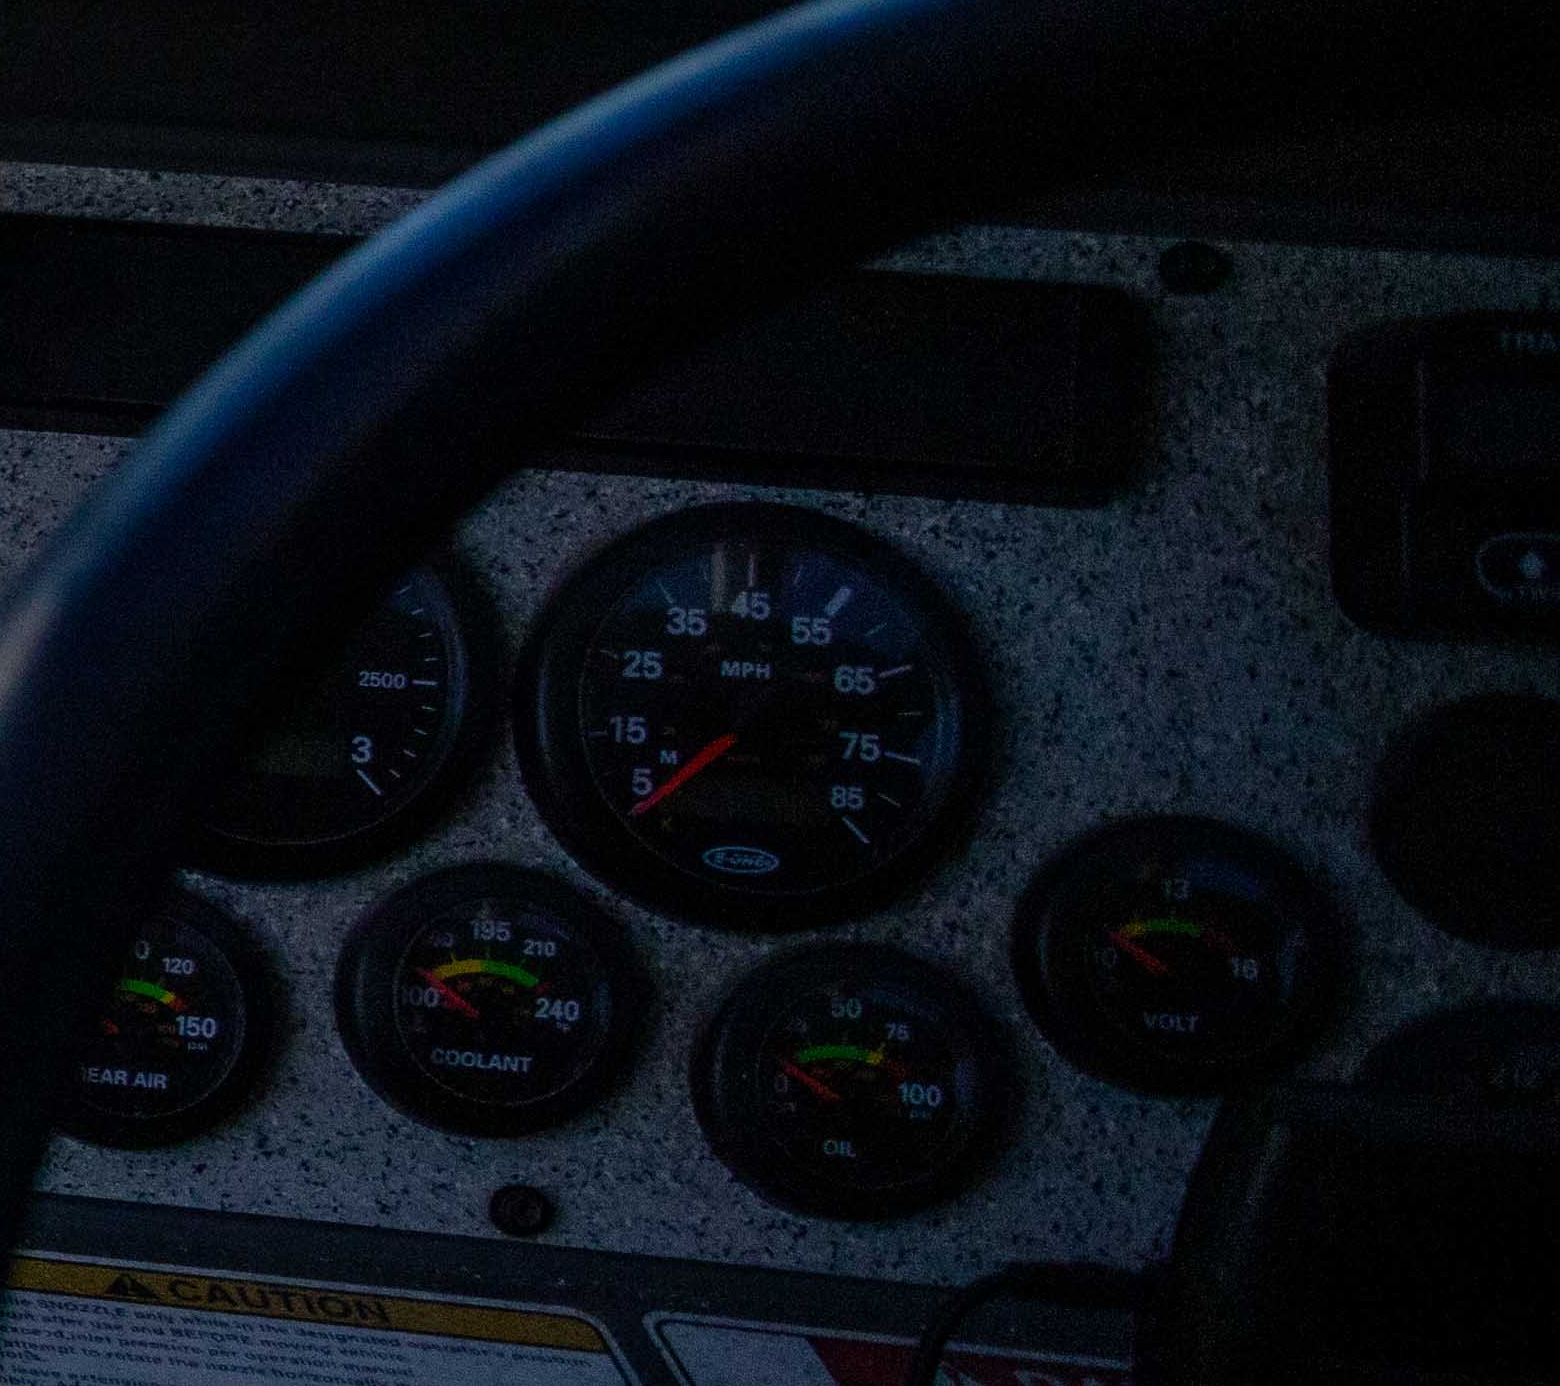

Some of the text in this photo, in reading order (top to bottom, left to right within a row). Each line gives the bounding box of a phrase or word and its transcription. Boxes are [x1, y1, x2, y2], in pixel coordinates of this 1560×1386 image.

[731, 590, 770, 621] 45
[666, 607, 707, 637] 35
[791, 616, 832, 646] 55
[622, 649, 663, 679] 25
[721, 661, 771, 678] MPH
[359, 670, 408, 689] 2500
[833, 665, 874, 695] 65
[610, 716, 647, 745] 15
[351, 736, 373, 763] 3
[839, 732, 880, 762] 75
[632, 767, 653, 796] 5
[831, 785, 864, 810] 85
[472, 919, 511, 942] 195
[523, 939, 556, 957] 210
[161, 957, 196, 975] 120
[534, 997, 580, 1022] 240
[176, 1015, 217, 1038] 150
[888, 1021, 911, 1041] 75
[1142, 1012, 1200, 1033] VOLT
[431, 1048, 533, 1073] COOLANT
[133, 1071, 168, 1090] AIR
[897, 1081, 943, 1107] 100
[824, 1141, 857, 1158] OIL
[168, 1278, 390, 1322] CAUTION
